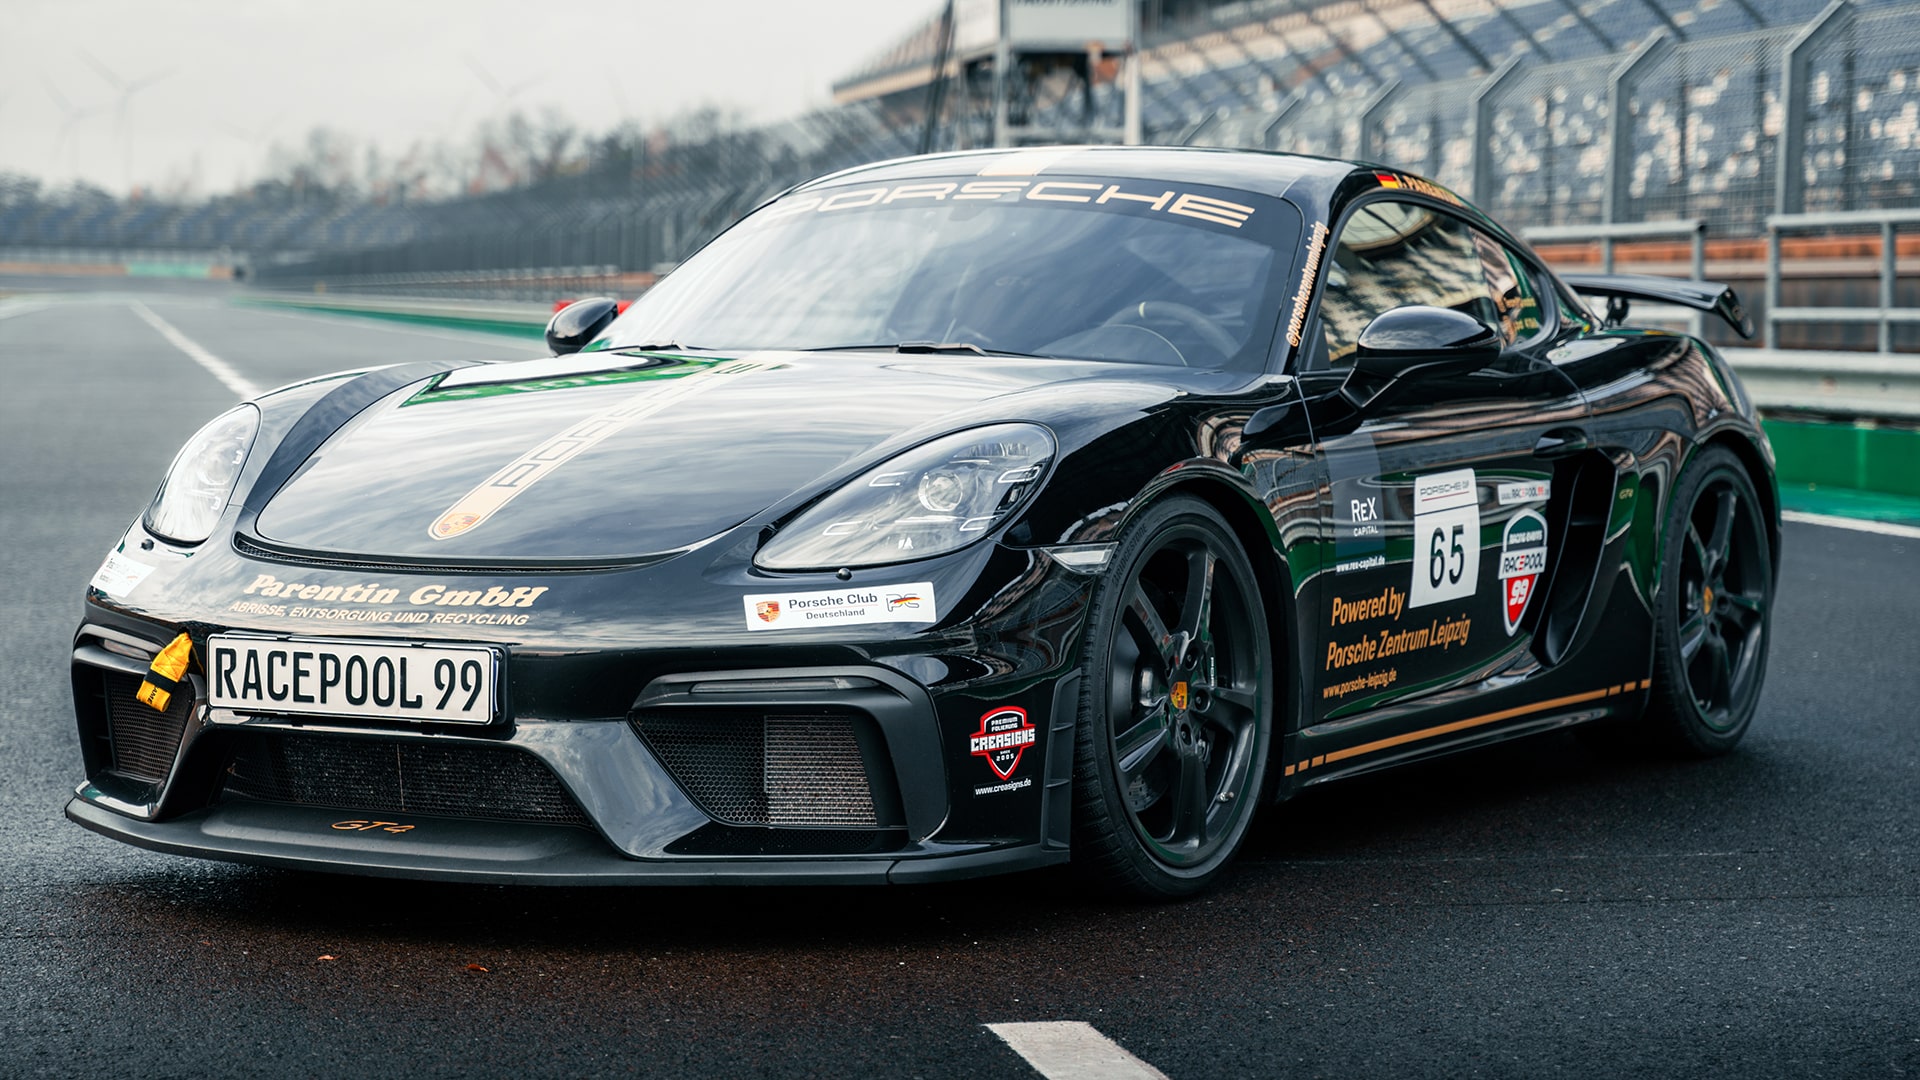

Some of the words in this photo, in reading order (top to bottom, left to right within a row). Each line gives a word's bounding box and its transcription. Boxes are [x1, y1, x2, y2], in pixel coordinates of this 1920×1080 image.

[756, 180, 1256, 228] PORSCHE
[1285, 220, 1330, 347] @porschezentrumleipzig
[1419, 482, 1464, 496] PORSCHE
[1353, 525, 1379, 537] CAPITAL
[1336, 555, 1385, 573] www.rex-capital.de
[1429, 524, 1465, 589] 65
[1503, 552, 1544, 574] RACEPOOL
[243, 574, 401, 605] Parentin
[408, 583, 550, 608] GmbH
[789, 595, 844, 609] Porsche
[846, 593, 878, 604] Club
[1509, 578, 1530, 606] 99
[228, 601, 287, 618] ABRISSE,
[288, 607, 394, 624] ENTSORGUNG
[394, 612, 429, 625] UND
[430, 613, 530, 627] RECYCLING
[806, 608, 866, 620] Deutschland
[1331, 588, 1388, 627] Powered
[1388, 586, 1406, 621] by
[1326, 634, 1377, 671] Porsche
[1377, 628, 1430, 659] Zentrum
[1429, 613, 1471, 650] Leipzig
[215, 647, 423, 710] RACEPOOL
[433, 658, 483, 711] 99
[1323, 667, 1397, 699] www.porsche-leipzig.de
[970, 728, 1036, 752] CREASIGNS
[996, 753, 1014, 762] 2005
[975, 777, 1032, 795] www.creasigns.de
[331, 820, 416, 834] GT4
